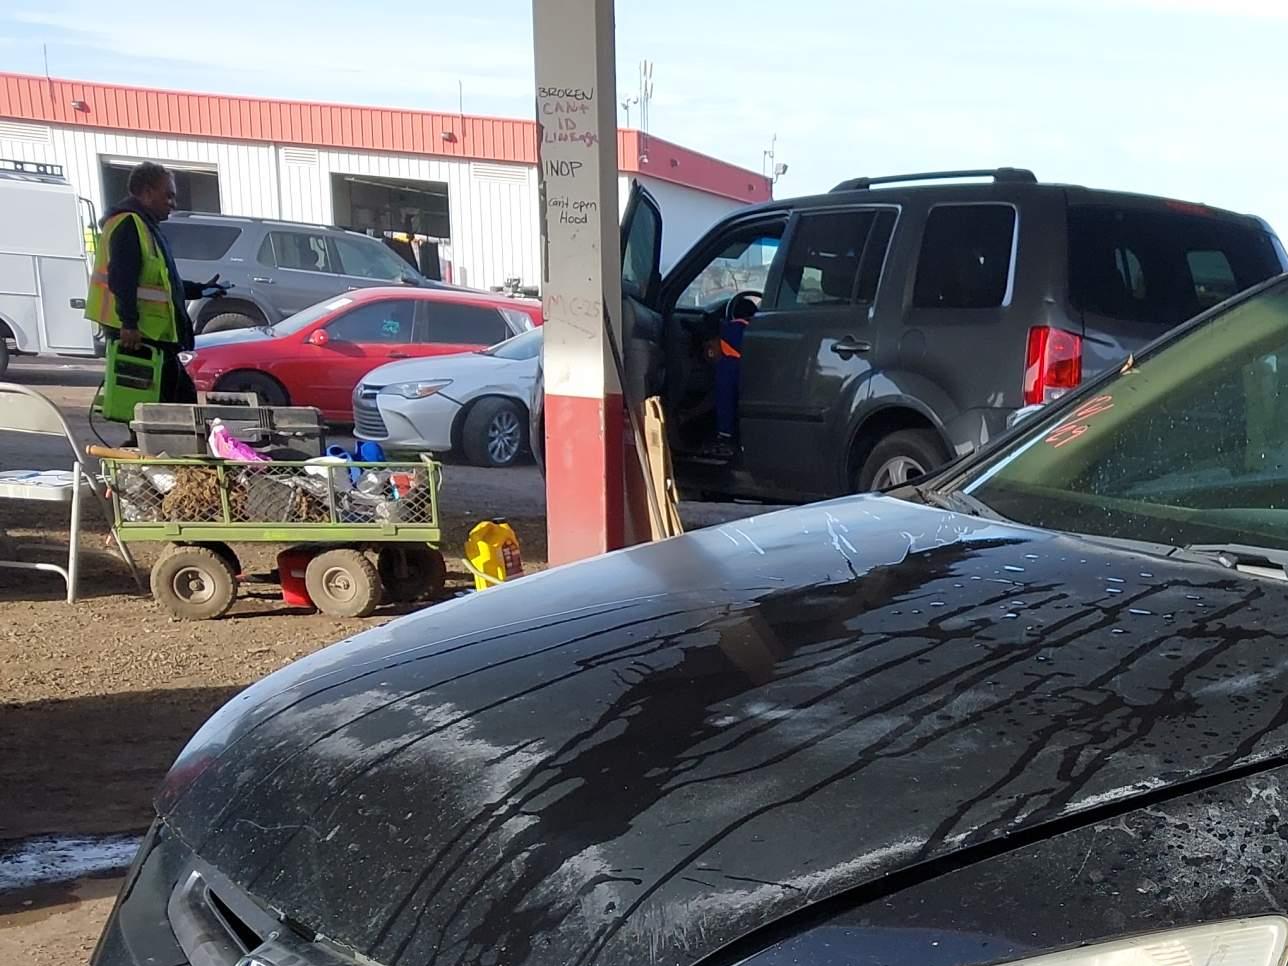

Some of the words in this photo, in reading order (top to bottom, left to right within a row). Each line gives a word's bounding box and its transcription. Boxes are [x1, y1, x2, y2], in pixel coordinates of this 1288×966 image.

[538, 87, 594, 101] BROKEN
[558, 118, 577, 131] ID
[545, 160, 583, 177] INOP
[560, 210, 588, 224] Hood
